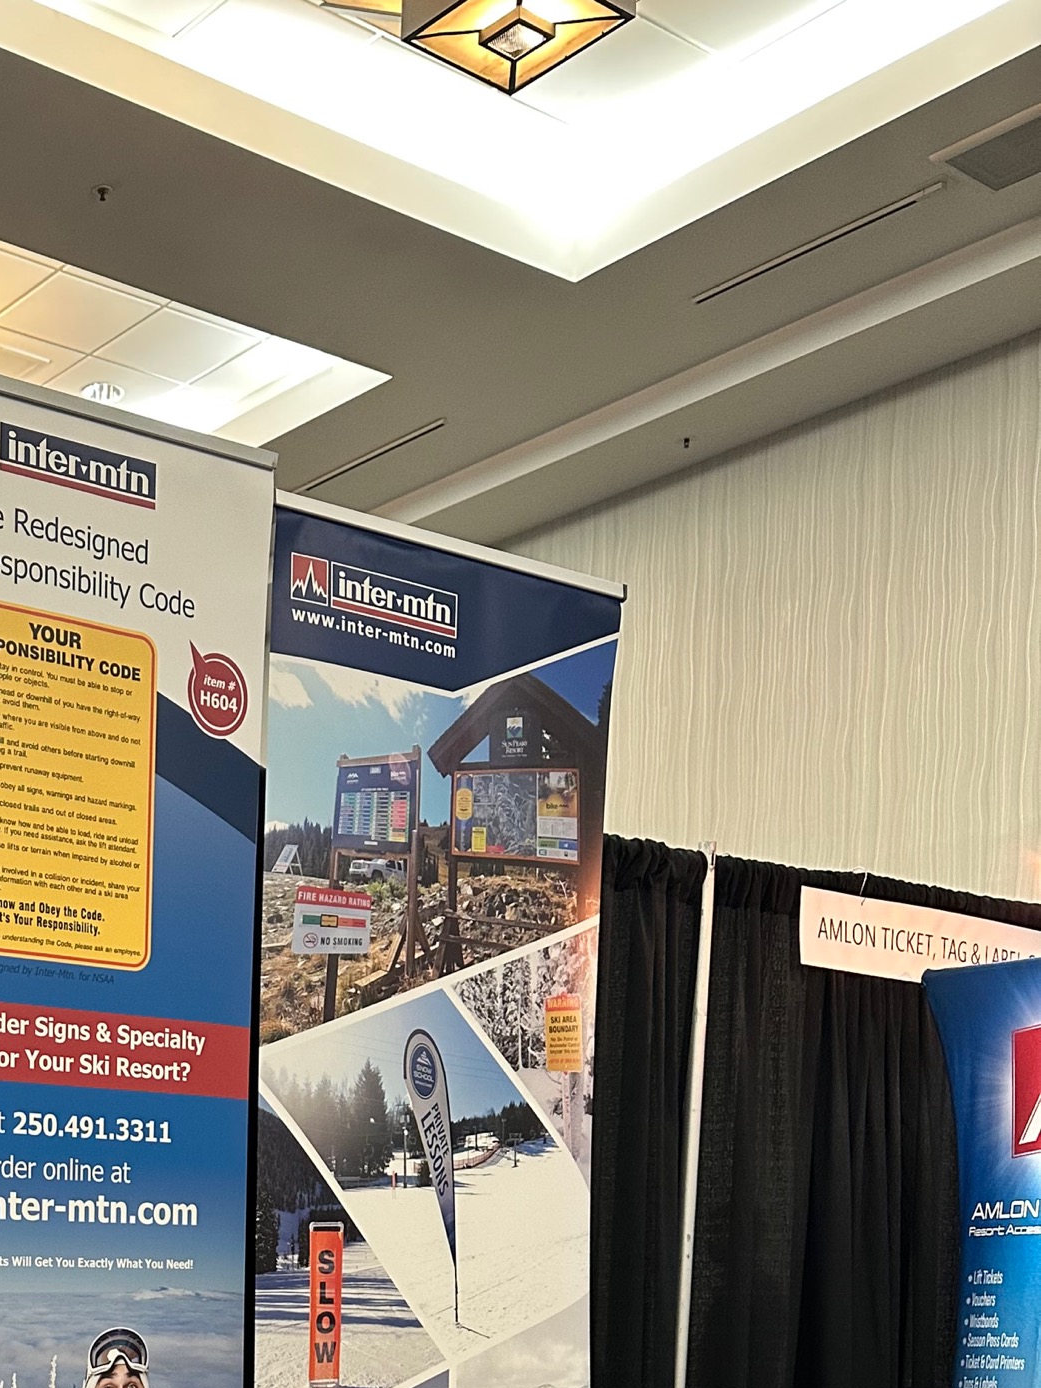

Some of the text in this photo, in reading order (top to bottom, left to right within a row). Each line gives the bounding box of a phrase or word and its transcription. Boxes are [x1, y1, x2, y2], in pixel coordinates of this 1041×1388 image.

[15, 508, 149, 565] Redesigned
[140, 583, 196, 618] Code
[29, 622, 82, 649] YOUR
[291, 608, 456, 659] www.inter-mtn.com
[99, 660, 140, 681] CODE
[203, 674, 236, 691] item #
[200, 692, 238, 713] H604
[298, 891, 371, 907] FIRE HAZARD RATING
[19, 901, 35, 912] and
[39, 903, 60, 918] Obey
[64, 906, 77, 918] the
[81, 909, 105, 922] Code.
[14, 915, 32, 926] Your
[37, 917, 100, 936] Responsibility.
[320, 937, 362, 946] NO SMOKING
[818, 917, 877, 947] AMLON
[882, 927, 936, 960] TICKET,
[941, 936, 967, 963] TAG
[971, 943, 980, 965] &
[22, 965, 32, 976] by
[79, 972, 90, 981] for
[92, 973, 114, 984] NSAA
[34, 1017, 90, 1043] Signs
[96, 1023, 111, 1043] &
[117, 1026, 205, 1055] Specialty
[549, 1025, 578, 1033] BOUNDARY
[25, 1048, 73, 1074] Your
[79, 1054, 110, 1076] Ski
[116, 1058, 191, 1082] Resort?
[13, 1111, 172, 1144] 250.491.3311
[431, 1103, 450, 1157] PRIVATE
[421, 1111, 448, 1197] LESSONS
[43, 1159, 104, 1183] online
[111, 1162, 131, 1184] at
[971, 1200, 1039, 1220] AMLON
[969, 1225, 1005, 1237] Resort
[11, 1256, 31, 1267] Will
[34, 1256, 52, 1268] Get
[55, 1257, 75, 1268] You
[77, 1257, 113, 1270] Exactly
[116, 1258, 142, 1269] What
[145, 1258, 163, 1269] You
[166, 1259, 193, 1270] Need!
[983, 1270, 1003, 1284] Tickets
[314, 1248, 337, 1364] SLOW
[967, 1333, 1019, 1348] Season Pass Cards
[965, 1354, 980, 1368] Ticket
[1001, 1355, 1024, 1370] Printers
